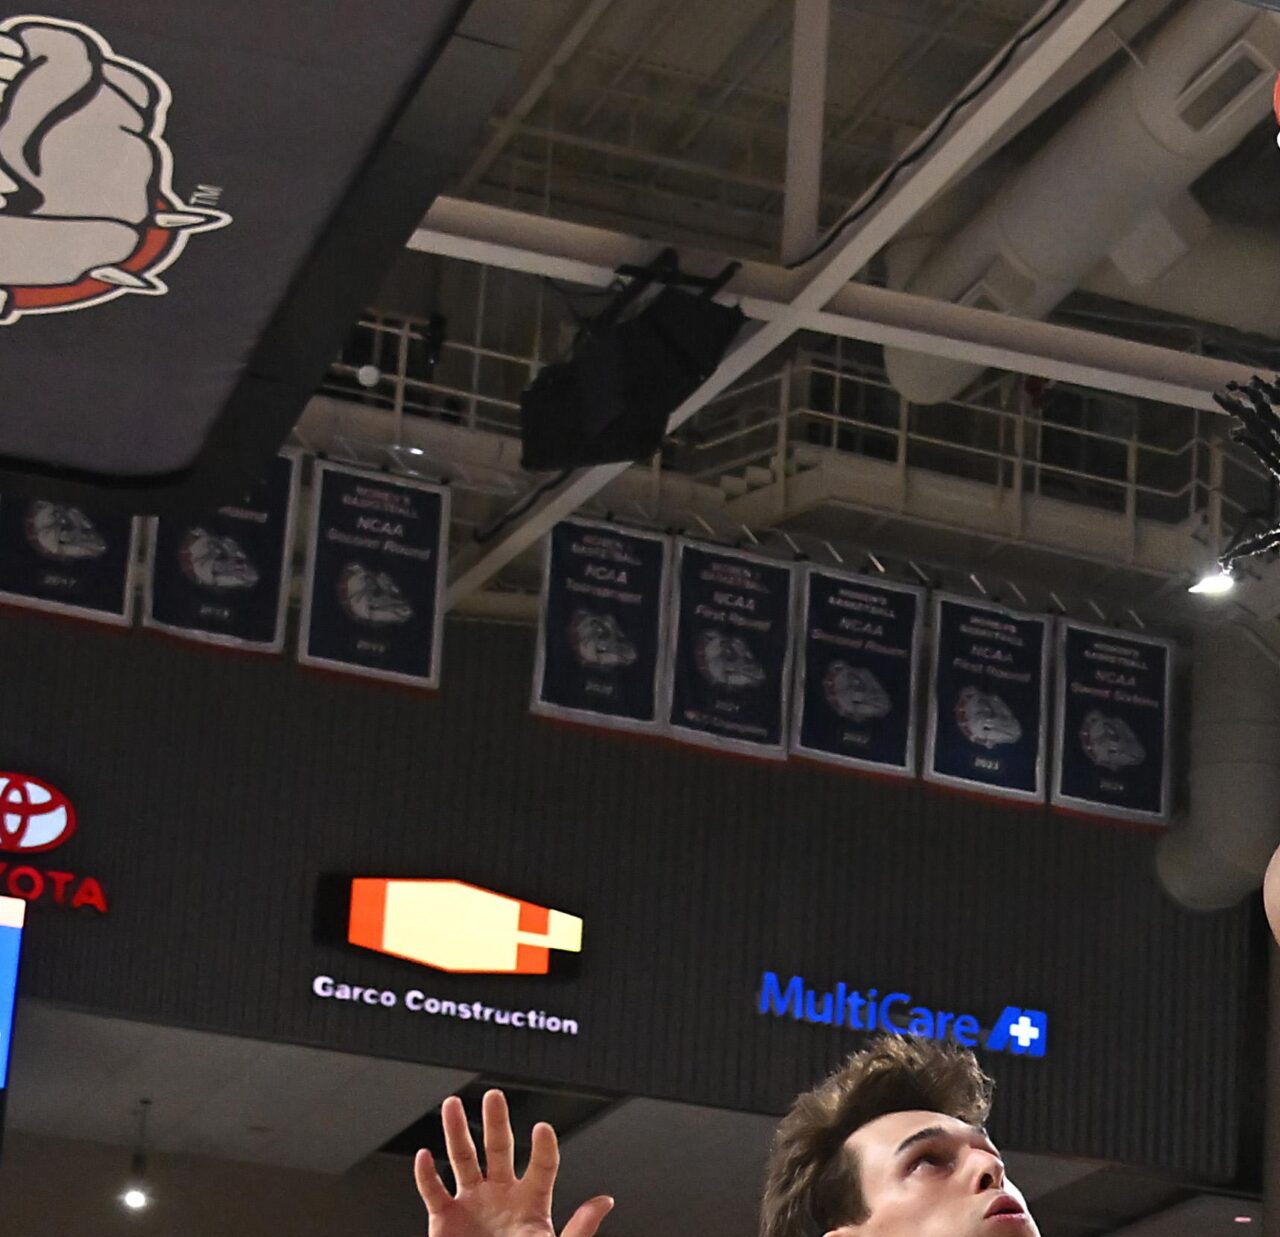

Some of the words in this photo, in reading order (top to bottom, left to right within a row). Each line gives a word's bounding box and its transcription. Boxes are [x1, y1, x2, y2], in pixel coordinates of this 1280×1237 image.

[313, 975, 397, 1008] Garco
[405, 990, 579, 1035] Construction
[758, 971, 980, 1048] MultiCare
